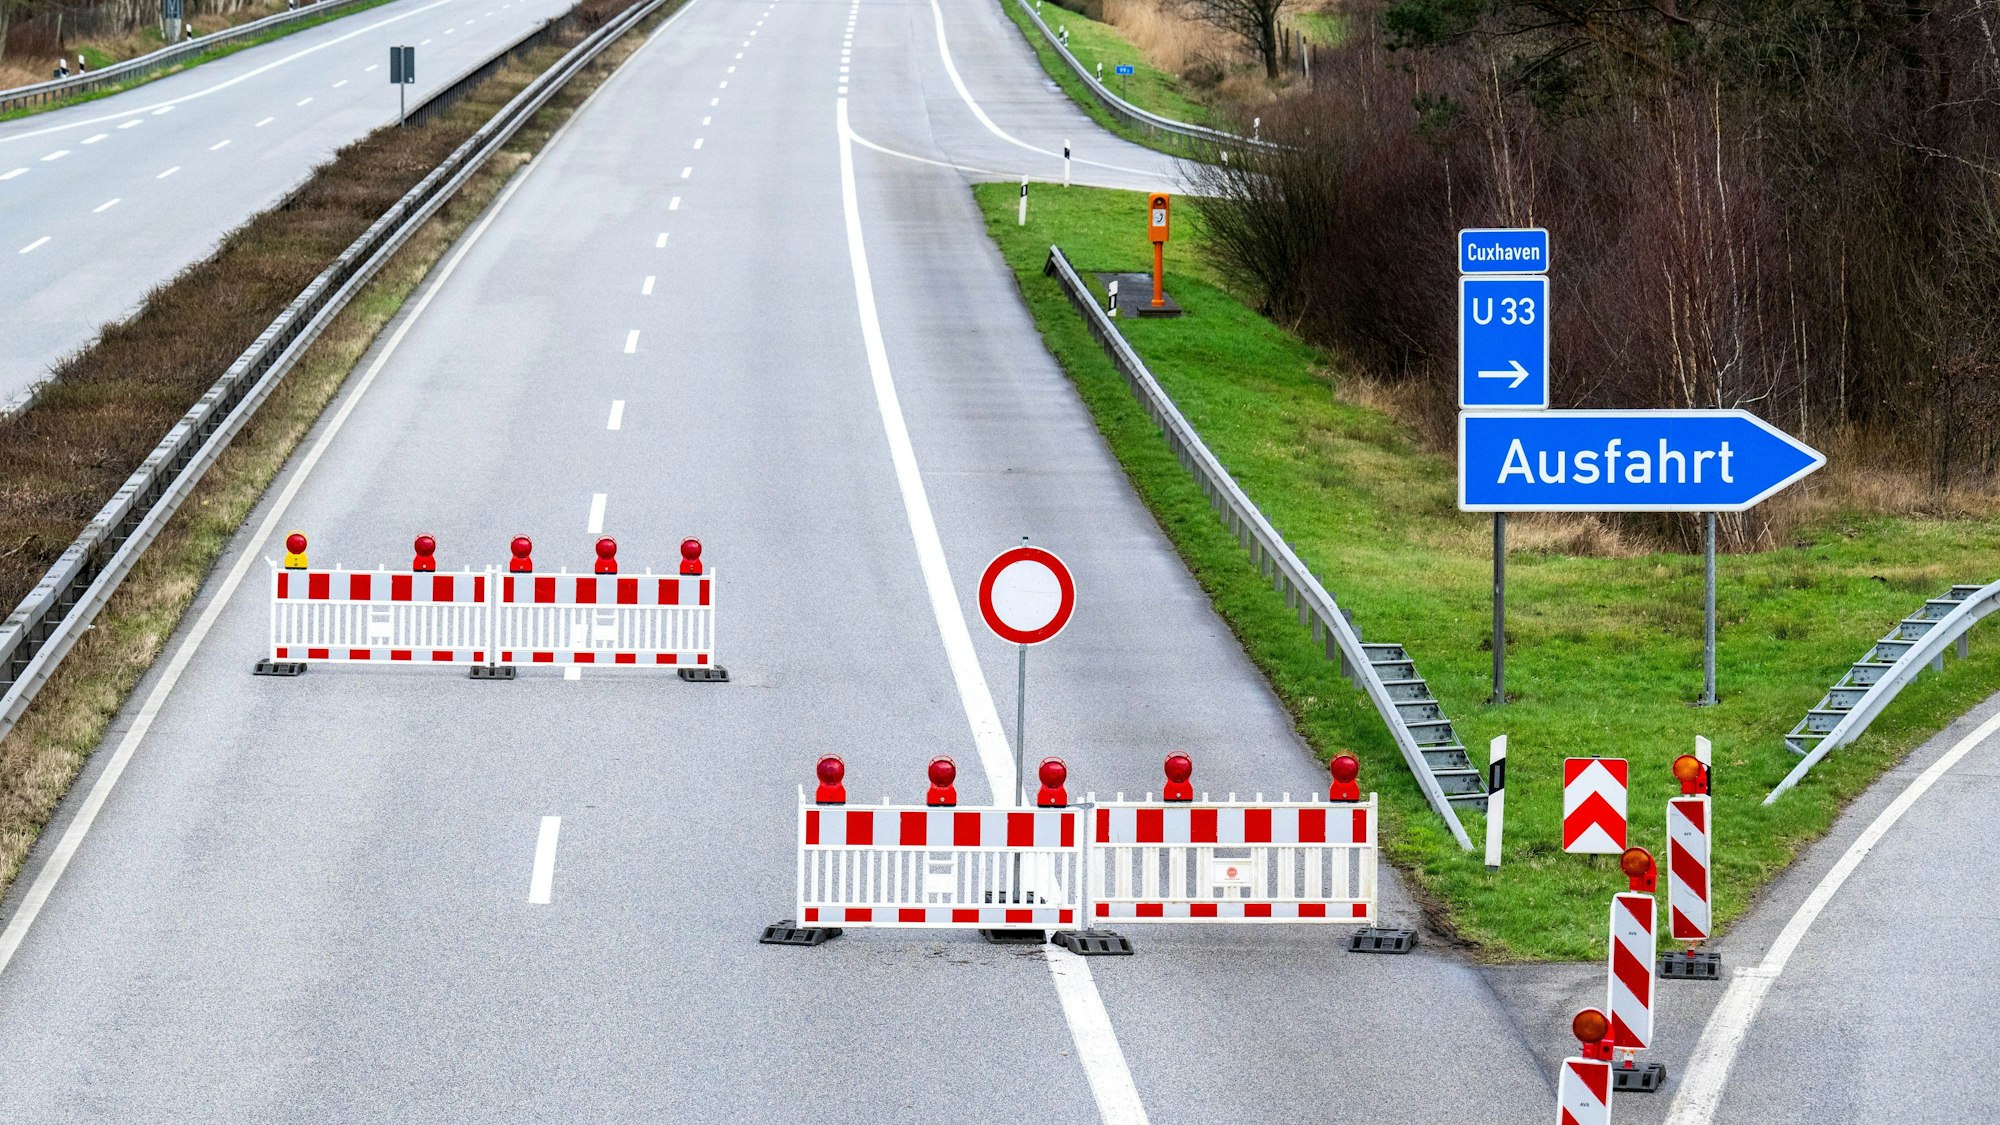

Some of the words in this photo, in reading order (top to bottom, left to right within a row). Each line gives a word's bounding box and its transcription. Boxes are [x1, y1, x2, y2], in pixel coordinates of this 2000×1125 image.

[1467, 243, 1540, 261] Cuxhaven
[1472, 297, 1493, 325] U
[1500, 297, 1535, 325] 33
[1497, 438, 1734, 484] Ausfahrt
